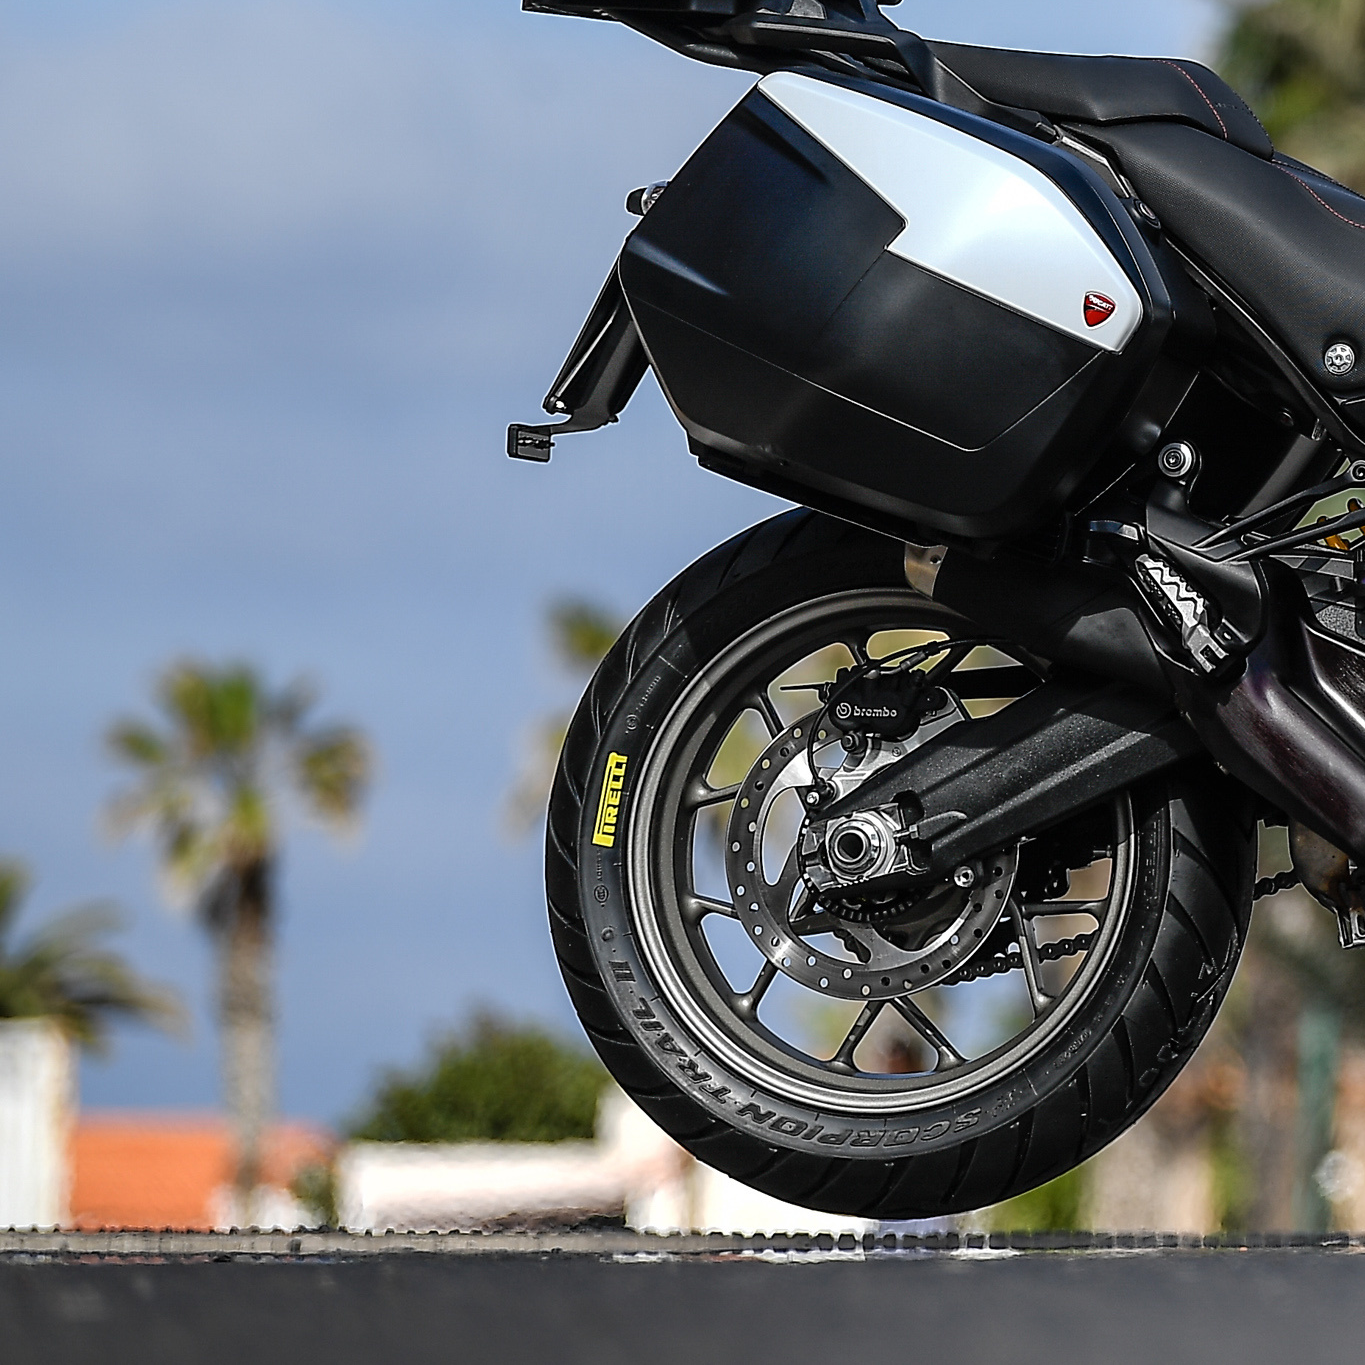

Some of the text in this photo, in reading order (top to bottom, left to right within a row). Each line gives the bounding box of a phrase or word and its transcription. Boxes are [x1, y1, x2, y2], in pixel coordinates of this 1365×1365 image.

[853, 705, 897, 717] brembo
[591, 751, 628, 848] PIRELLI
[632, 996, 732, 1105] TRAIL
[735, 1101, 983, 1148] SCORPION
